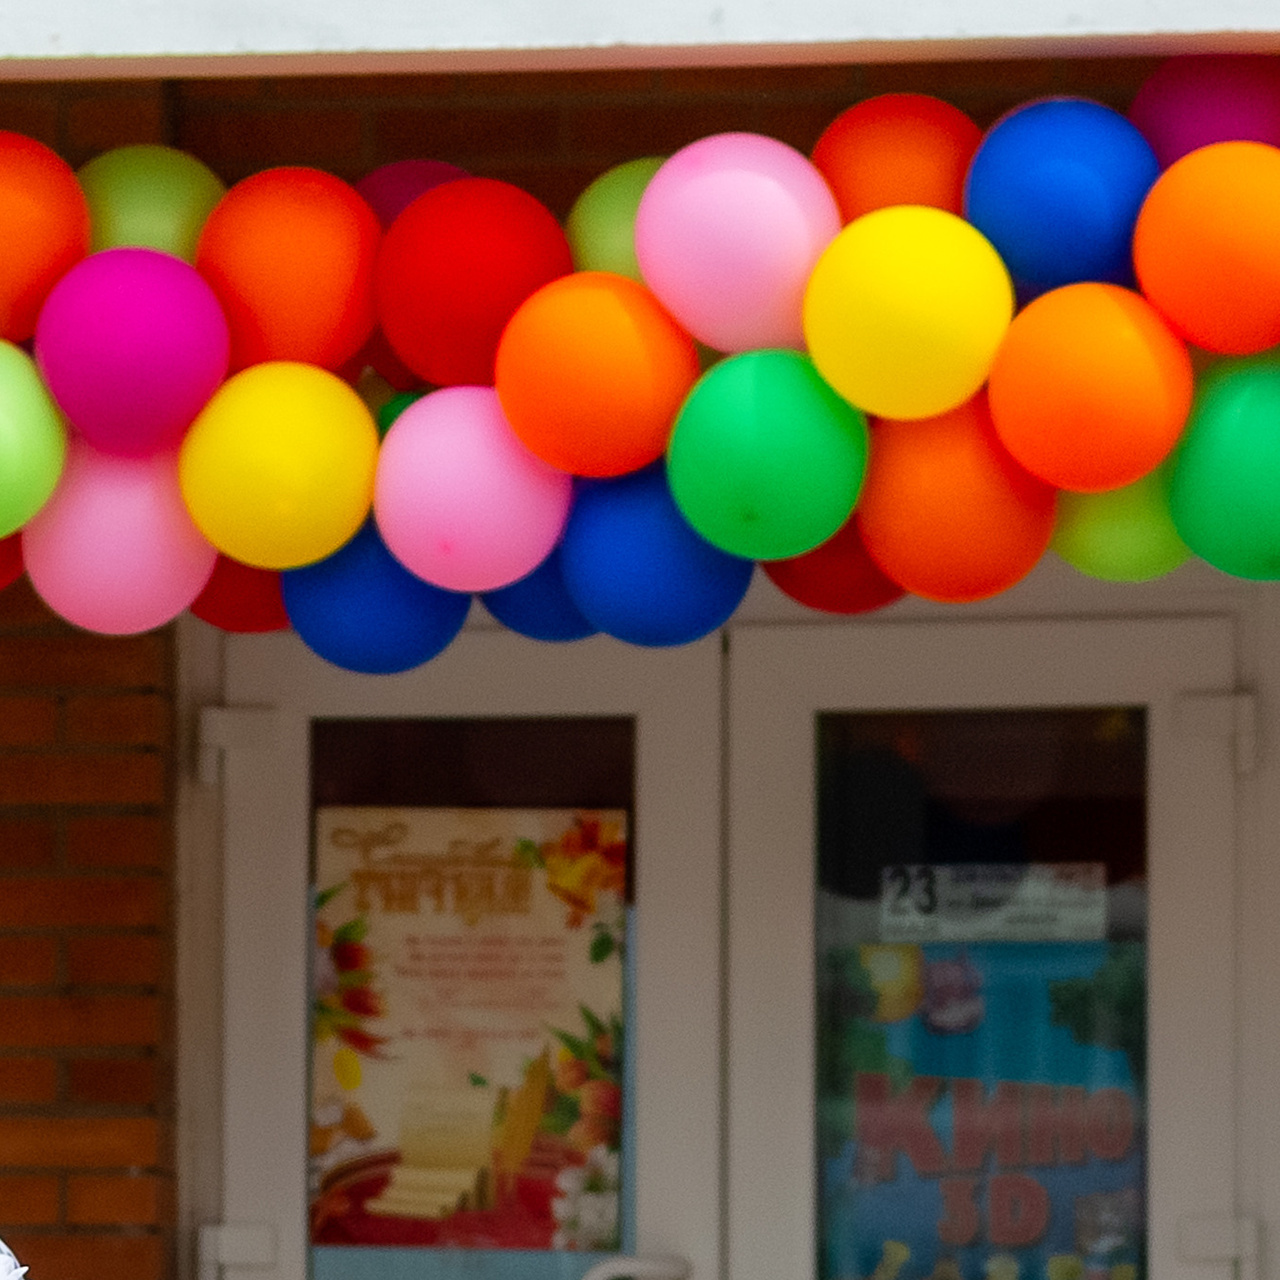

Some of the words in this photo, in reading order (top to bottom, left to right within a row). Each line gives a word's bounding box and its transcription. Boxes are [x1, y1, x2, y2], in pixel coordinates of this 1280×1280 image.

[889, 865, 937, 914] 23
[854, 1072, 1133, 1184] КИНО
[937, 1172, 1050, 1246] 3D
